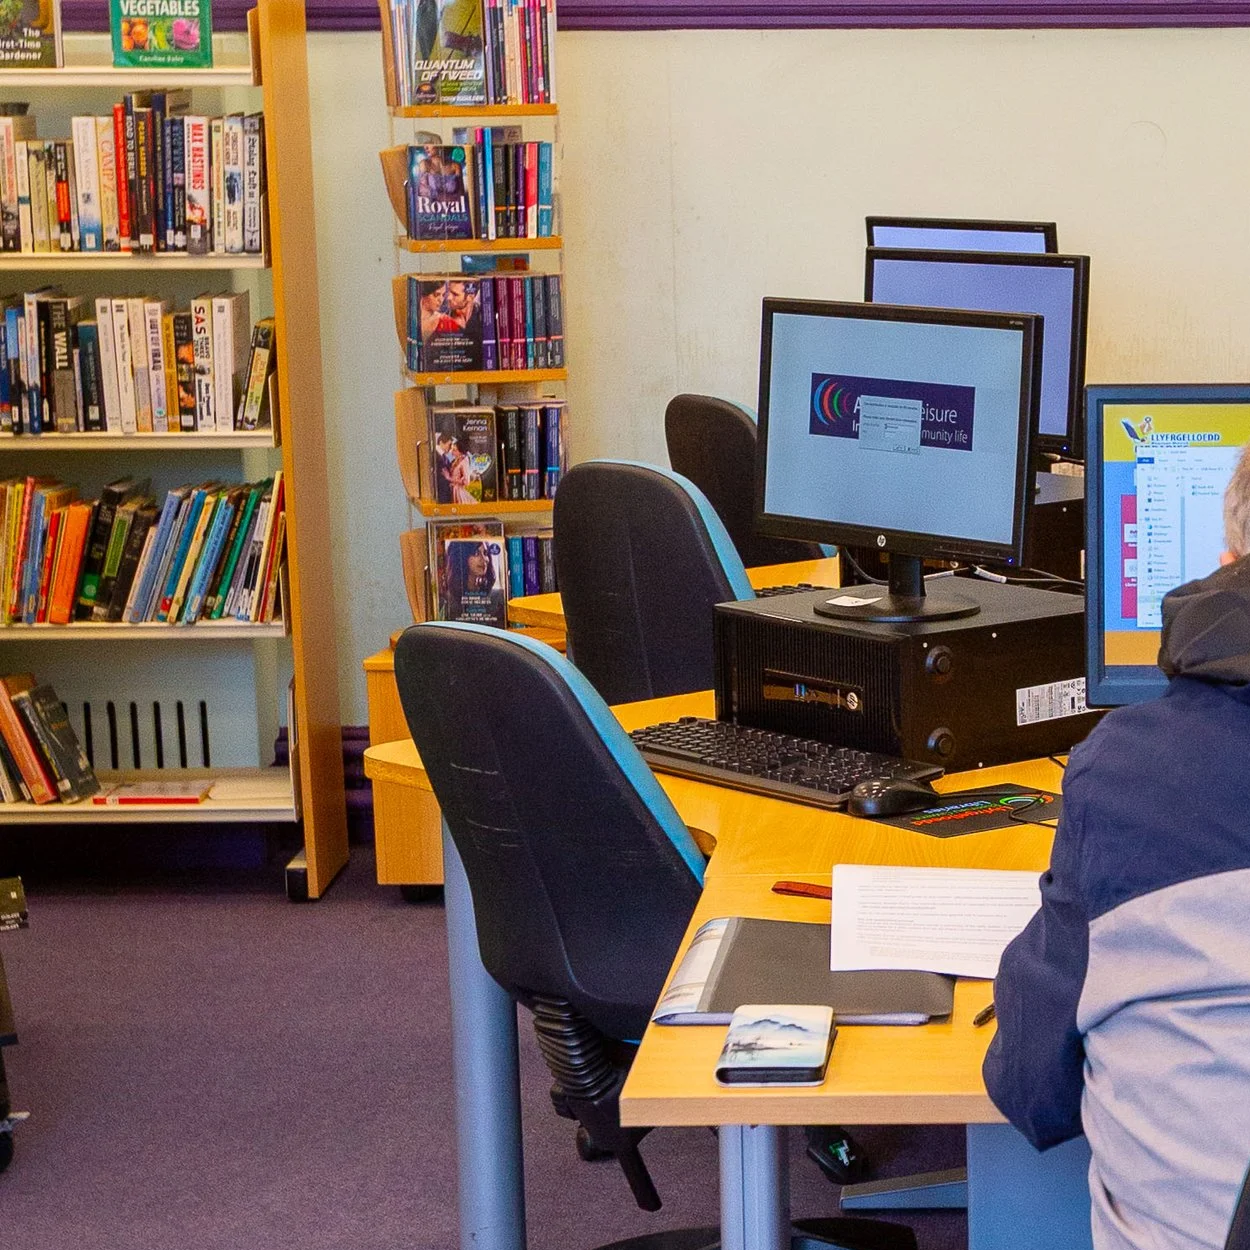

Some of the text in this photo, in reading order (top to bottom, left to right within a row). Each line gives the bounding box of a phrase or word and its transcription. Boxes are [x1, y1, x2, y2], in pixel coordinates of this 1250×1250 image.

[120, 0, 200, 16] VEGETABLES
[22, 27, 41, 37] The
[0, 38, 41, 49] irst-Time
[414, 59, 475, 70] QUANTUM
[421, 70, 483, 81] OF TWEED
[125, 115, 136, 180] ROAD TO BERLIN
[192, 123, 205, 190] MAX HASTINGS
[417, 195, 467, 215] Royal
[194, 306, 206, 335] SAS
[52, 303, 67, 369] THE WALL
[921, 403, 958, 424] eisure
[465, 418, 488, 426] Jenna
[921, 429, 968, 444] munity life
